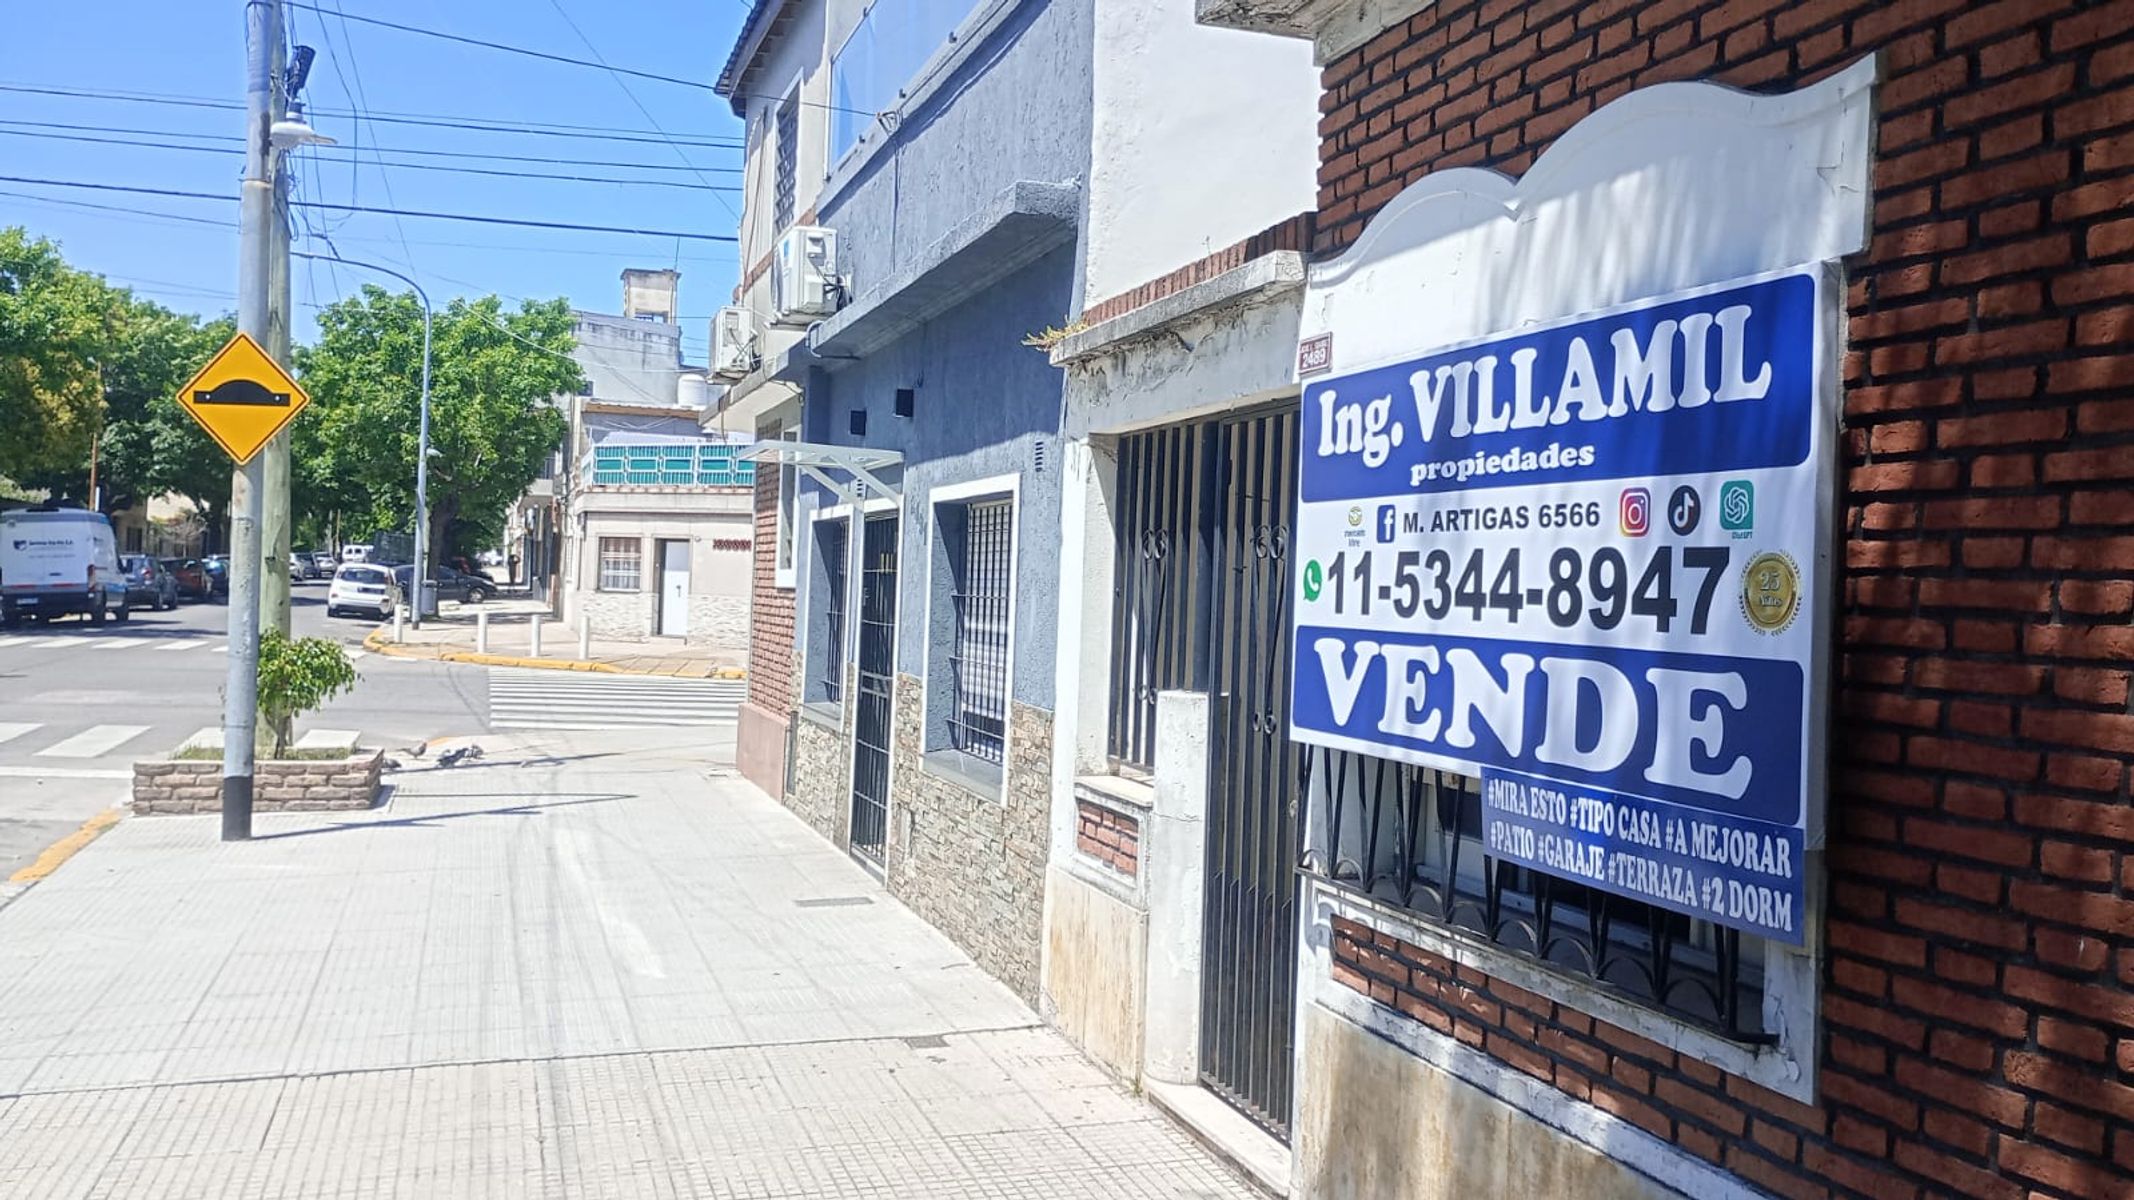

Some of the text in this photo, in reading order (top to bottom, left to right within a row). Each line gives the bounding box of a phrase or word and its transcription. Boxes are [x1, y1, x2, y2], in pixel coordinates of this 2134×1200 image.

[1302, 348, 1326, 368] 2489
[1317, 304, 1773, 468] Ing. VILLAMIL
[1409, 442, 1596, 487] propiedades
[1403, 501, 1601, 534] M. ARTIGAS 6566
[1326, 545, 1732, 636] 11-5344-8947
[1759, 571, 1780, 591] 25
[1313, 637, 1753, 801] VENDE
[1488, 778, 1793, 879] #MIRA ESTO #TIPO CASA #A MEJORAR
[1490, 820, 1793, 932] #PATIO #GARAJE #TERRAZA #2 DORM
